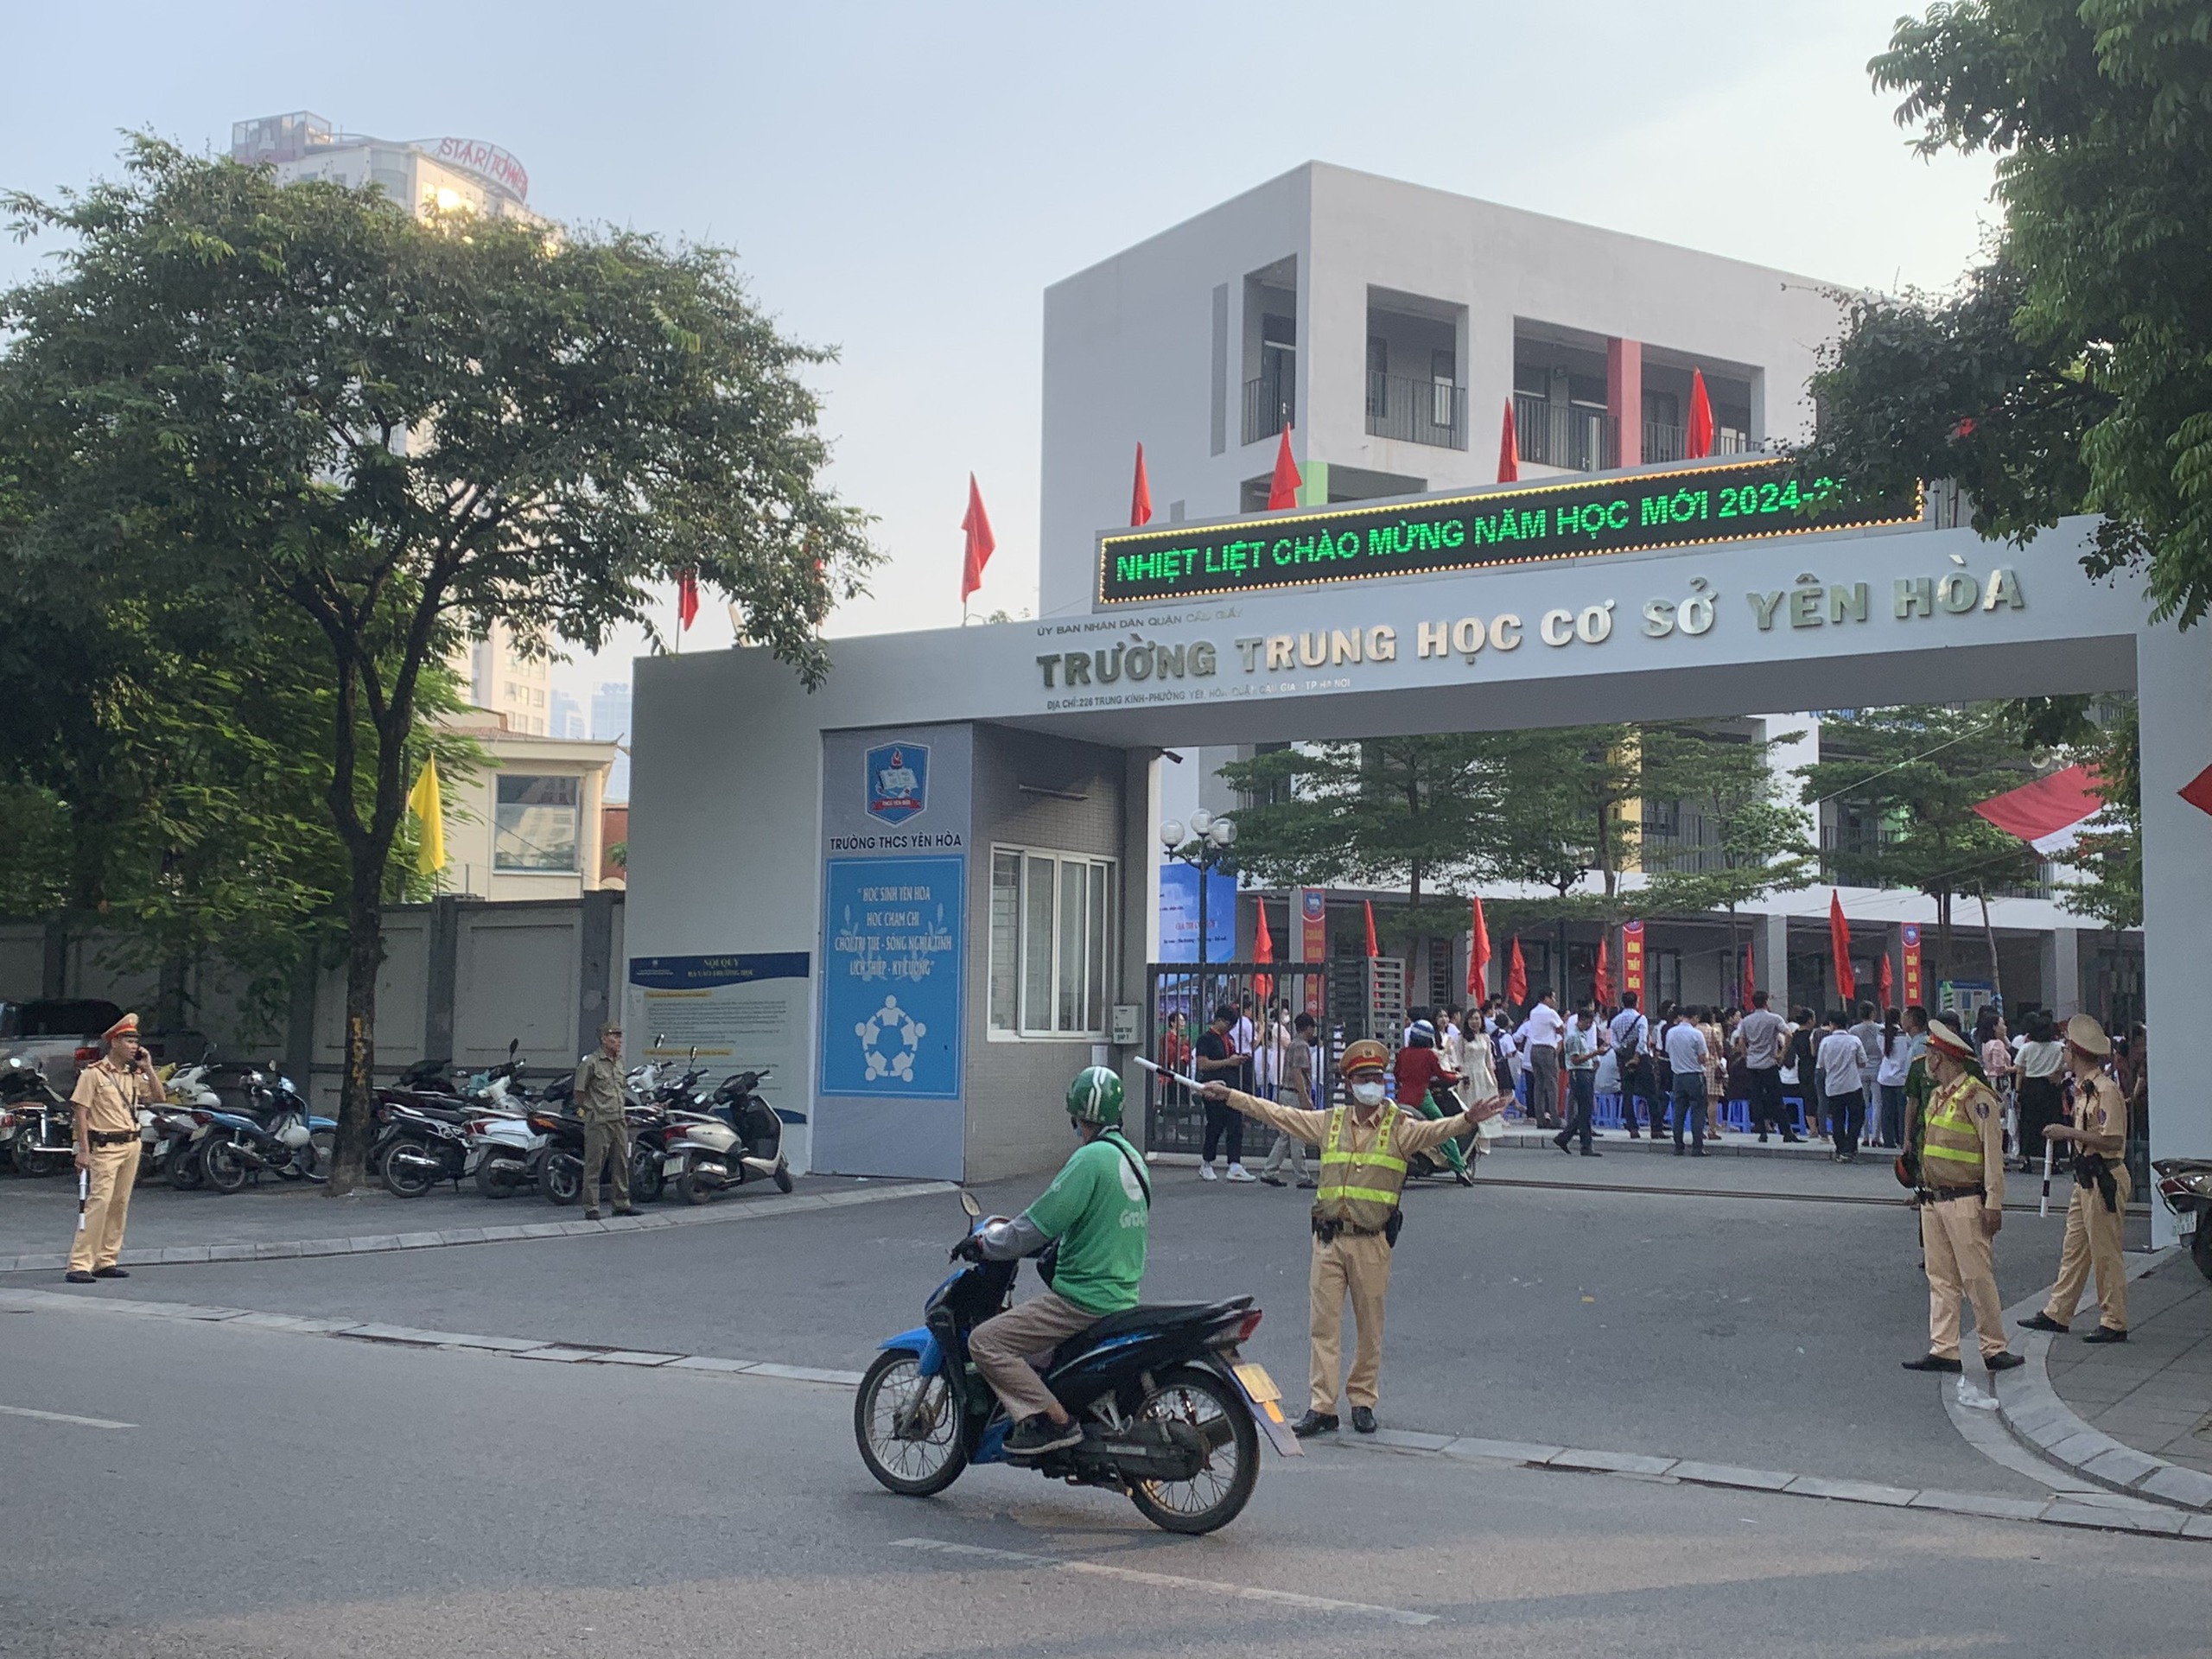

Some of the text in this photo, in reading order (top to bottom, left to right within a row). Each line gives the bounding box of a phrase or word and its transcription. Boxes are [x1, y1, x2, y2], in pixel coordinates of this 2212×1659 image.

[441, 137, 487, 168] STAR
[1116, 477, 1847, 583] NHIỆT LIỆT CHÀO MỪNG NĂM HỌC MỚI 2024-2
[1036, 554, 2025, 688] TRƯỜNG TRUNG HỌC CƠ SỞ YÊN HÒA
[1056, 624, 1080, 634] BAN
[1084, 620, 1116, 632] NHÂN
[1120, 618, 1144, 629] DÂN
[1148, 614, 1182, 627] QUẬN
[1095, 694, 1122, 706] TRUNG
[830, 830, 962, 850] TRƯỜNG THCS YÊN HÒA
